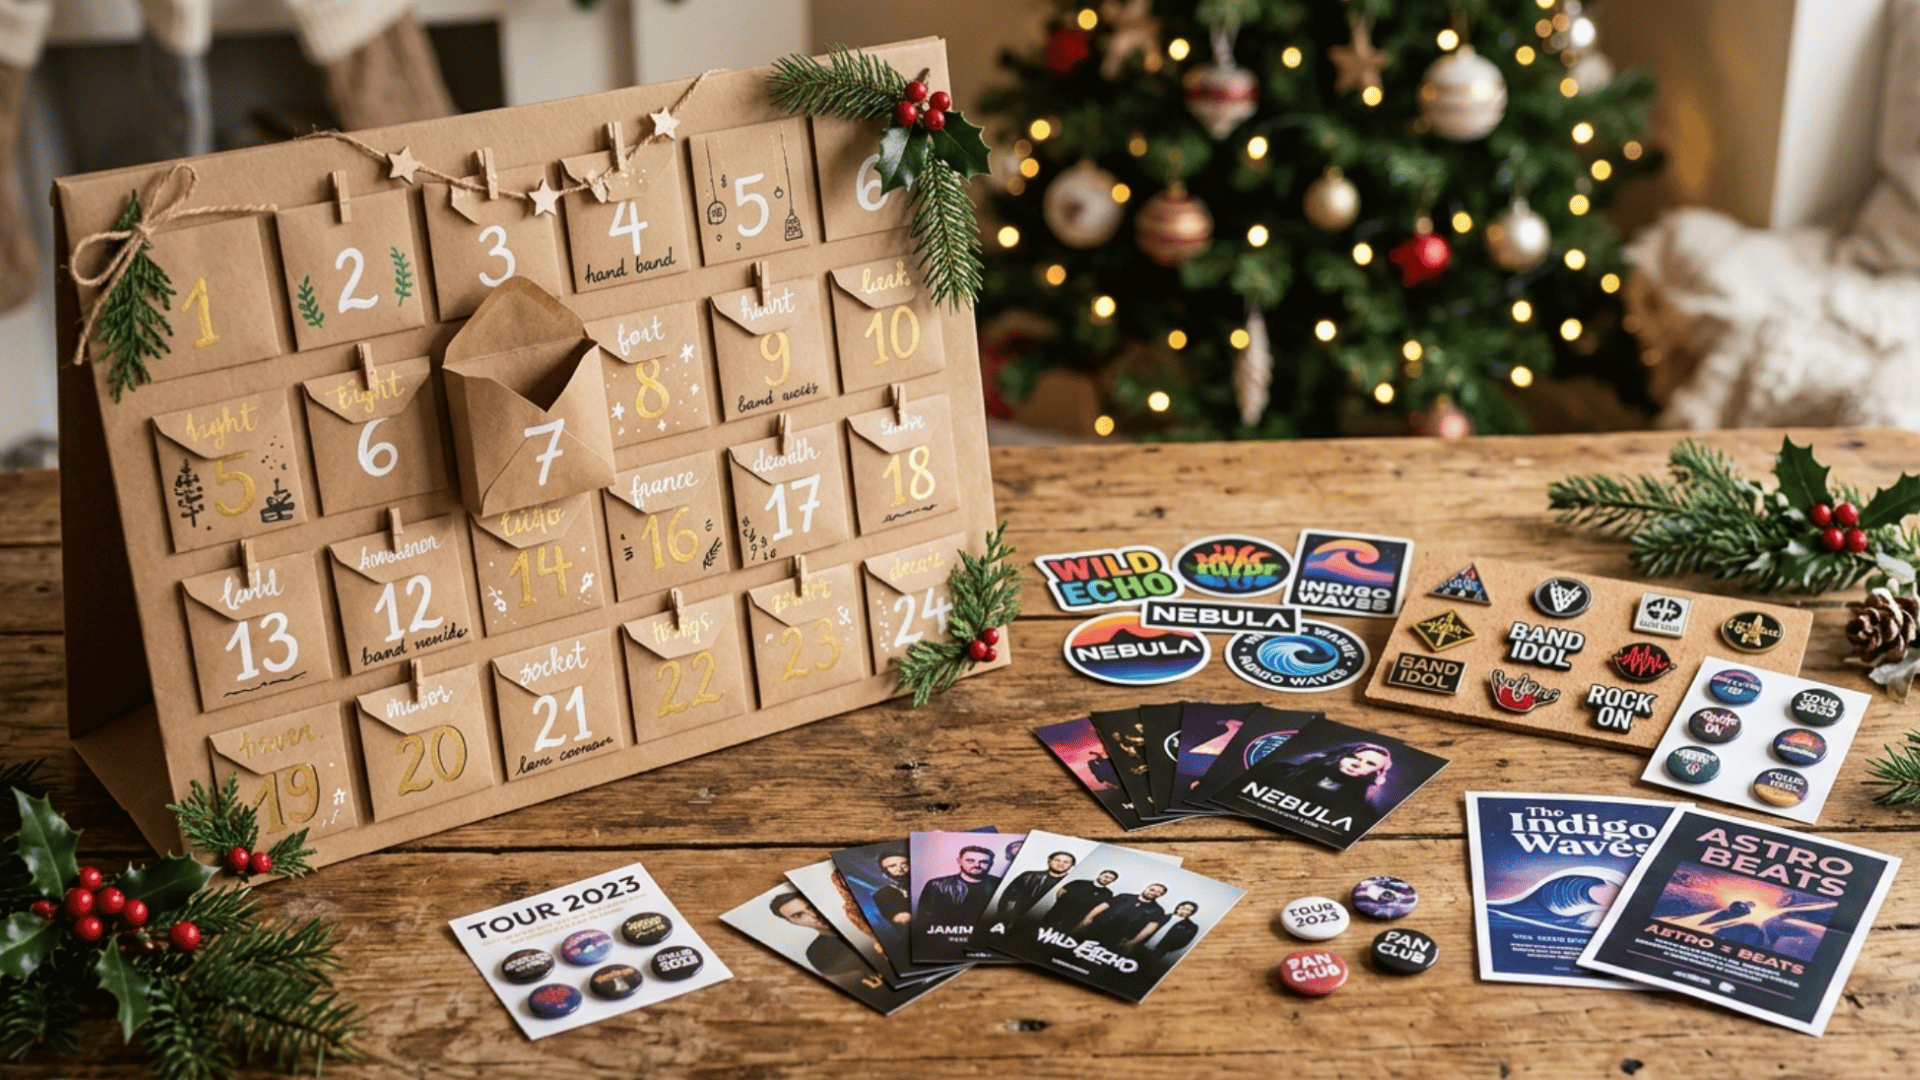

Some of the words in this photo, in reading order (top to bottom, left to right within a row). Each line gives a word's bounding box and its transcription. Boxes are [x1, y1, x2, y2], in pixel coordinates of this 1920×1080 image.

[734, 172, 769, 237] 5
[855, 153, 889, 211] 6
[478, 225, 516, 287] 3
[608, 201, 648, 255] 4
[334, 247, 379, 314] 2
[635, 247, 676, 274] band
[180, 277, 220, 348] 1
[864, 305, 920, 367] 10
[635, 358, 670, 419] 8
[760, 331, 790, 387] 9
[357, 417, 399, 477] 6
[524, 417, 565, 486] 7
[882, 445, 936, 508] 18
[213, 452, 255, 518] 5
[765, 473, 821, 541] 17
[641, 506, 699, 570] 16
[1048, 551, 1160, 582] WILD
[507, 545, 574, 609] 14
[1060, 571, 1174, 605] ECHO
[374, 574, 444, 643] 12
[893, 586, 954, 649] 24
[1152, 605, 1290, 629] NEBULA
[1510, 621, 1585, 651] BAND
[225, 611, 300, 681] 13
[780, 617, 841, 683] 23
[1075, 639, 1201, 662] NEBULA
[1399, 655, 1460, 677] BAND
[1510, 641, 1572, 669] IDOL
[656, 650, 724, 718] 22
[1399, 669, 1451, 690] IDOL
[1587, 684, 1656, 715] ROCK
[532, 684, 593, 752] 21
[1597, 706, 1634, 731] ON
[395, 724, 468, 797] 20
[251, 762, 321, 836] 19
[1241, 781, 1353, 831] NEBULA
[1509, 812, 1657, 842] Indigo
[1511, 832, 1650, 858] Waves
[1696, 827, 1854, 877] ASTRO
[1700, 846, 1848, 898] BEATS
[467, 902, 561, 939] TOUR
[562, 874, 641, 913] 2023
[1288, 902, 1336, 917] TOUR
[1377, 942, 1426, 964] CLUB
[1736, 948, 1806, 975] BEATS
